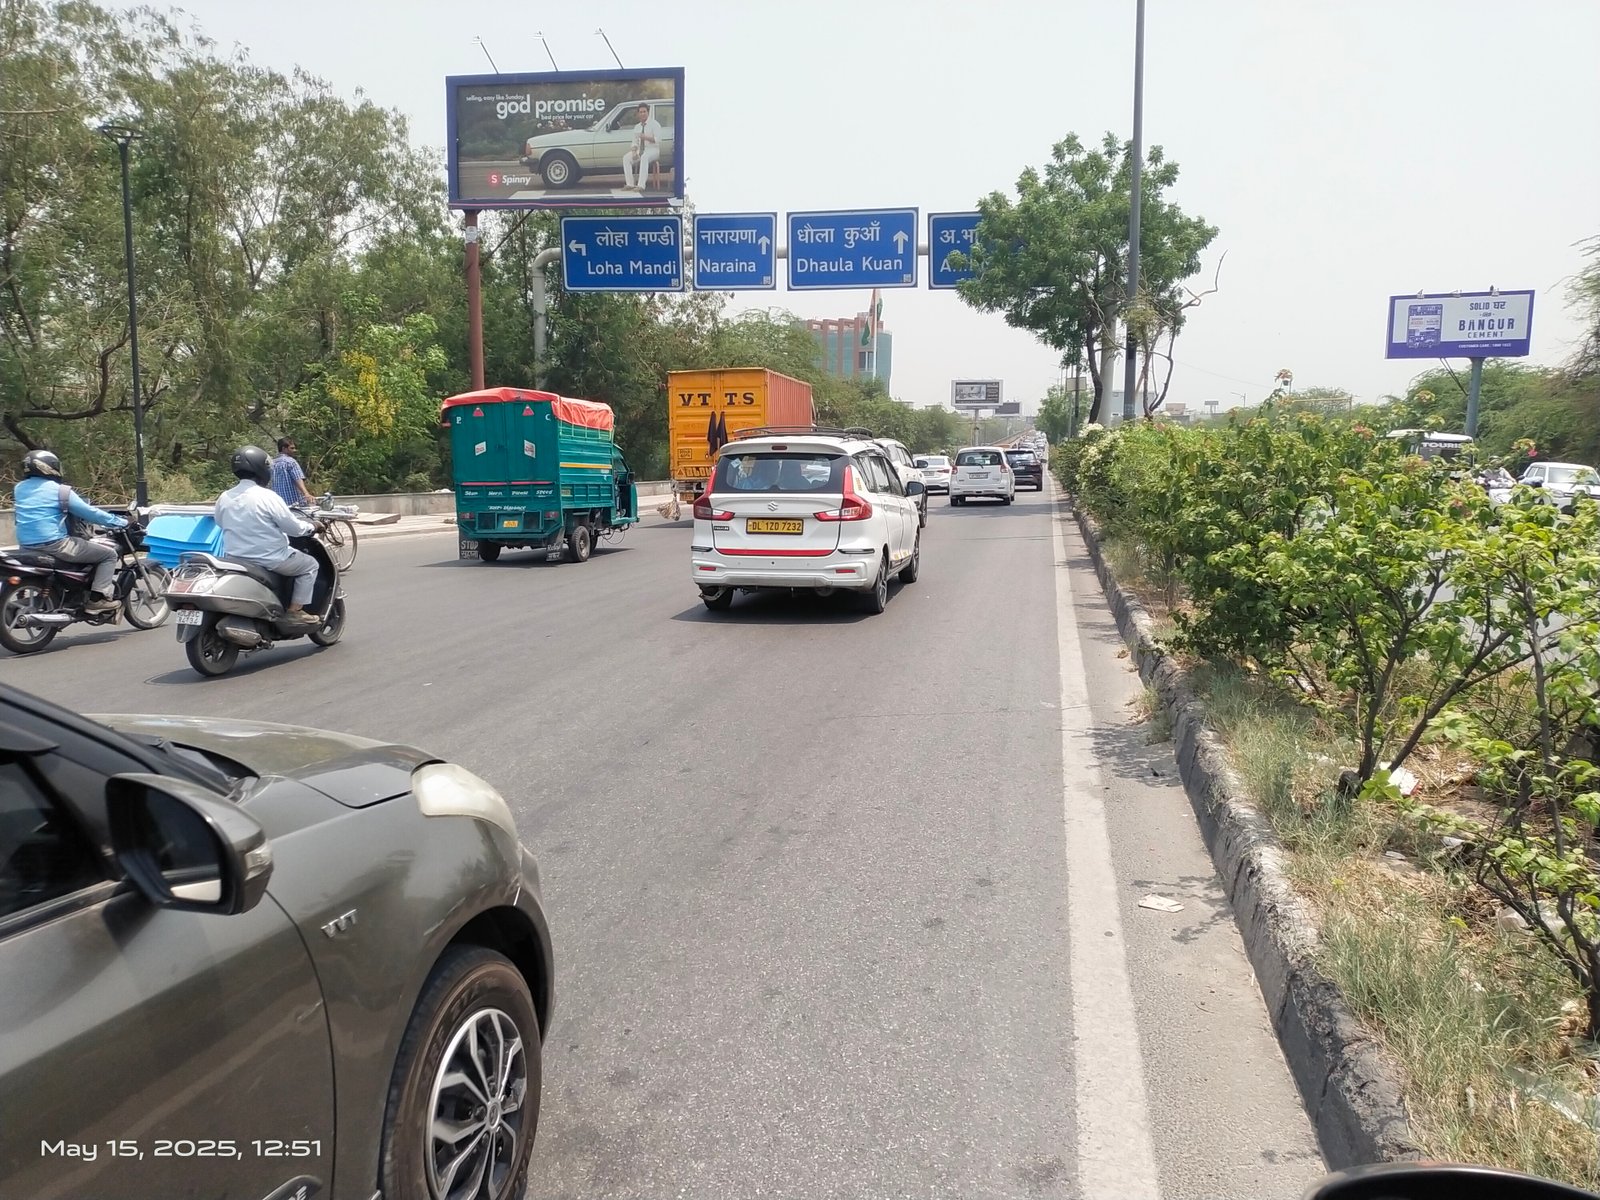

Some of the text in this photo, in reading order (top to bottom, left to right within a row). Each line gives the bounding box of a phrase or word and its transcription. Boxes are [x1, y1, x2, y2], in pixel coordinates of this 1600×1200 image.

[496, 93, 605, 119] god promise
[491, 174, 531, 186] S Spinny
[595, 225, 675, 248] लोहा मण्डी
[700, 229, 757, 244] नारायणा
[797, 220, 881, 248] धौला कुआँ
[587, 260, 676, 275] Loha Mandi
[700, 259, 756, 273] Naraina
[797, 257, 903, 273] Dhaula Kuan
[1469, 302, 1490, 311] SOLID
[1459, 318, 1515, 330] BANGUR
[1467, 331, 1504, 339] CEMENT
[752, 522, 762, 530] DL
[782, 522, 802, 531] 7232
[460, 540, 479, 550] STOP
